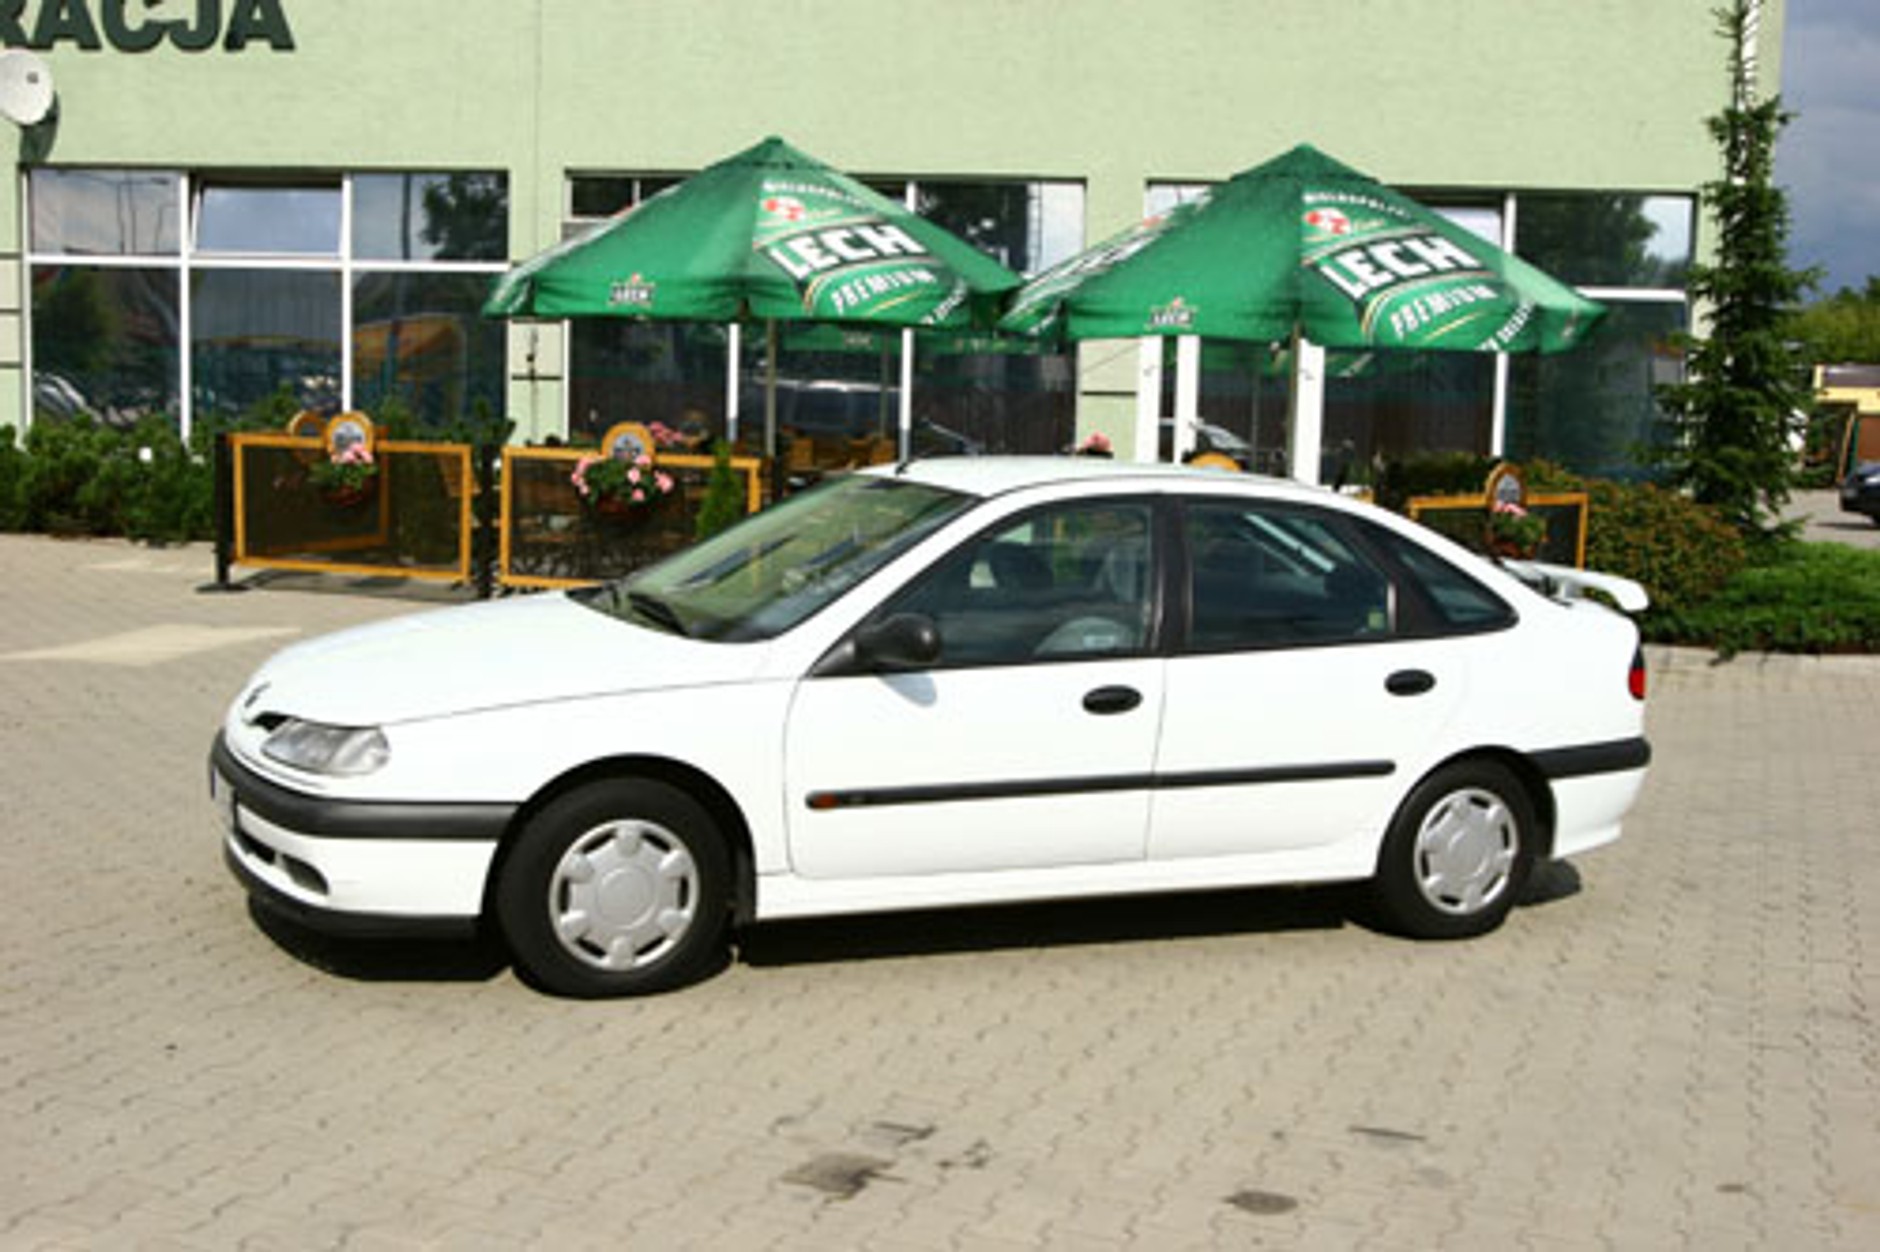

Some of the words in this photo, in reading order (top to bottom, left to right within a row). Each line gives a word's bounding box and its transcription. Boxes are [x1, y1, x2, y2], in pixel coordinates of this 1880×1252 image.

[769, 224, 927, 280] LECH
[1319, 235, 1482, 300] LECH
[830, 268, 938, 317] PREMIUM
[1389, 284, 1499, 342] PREMIUM
